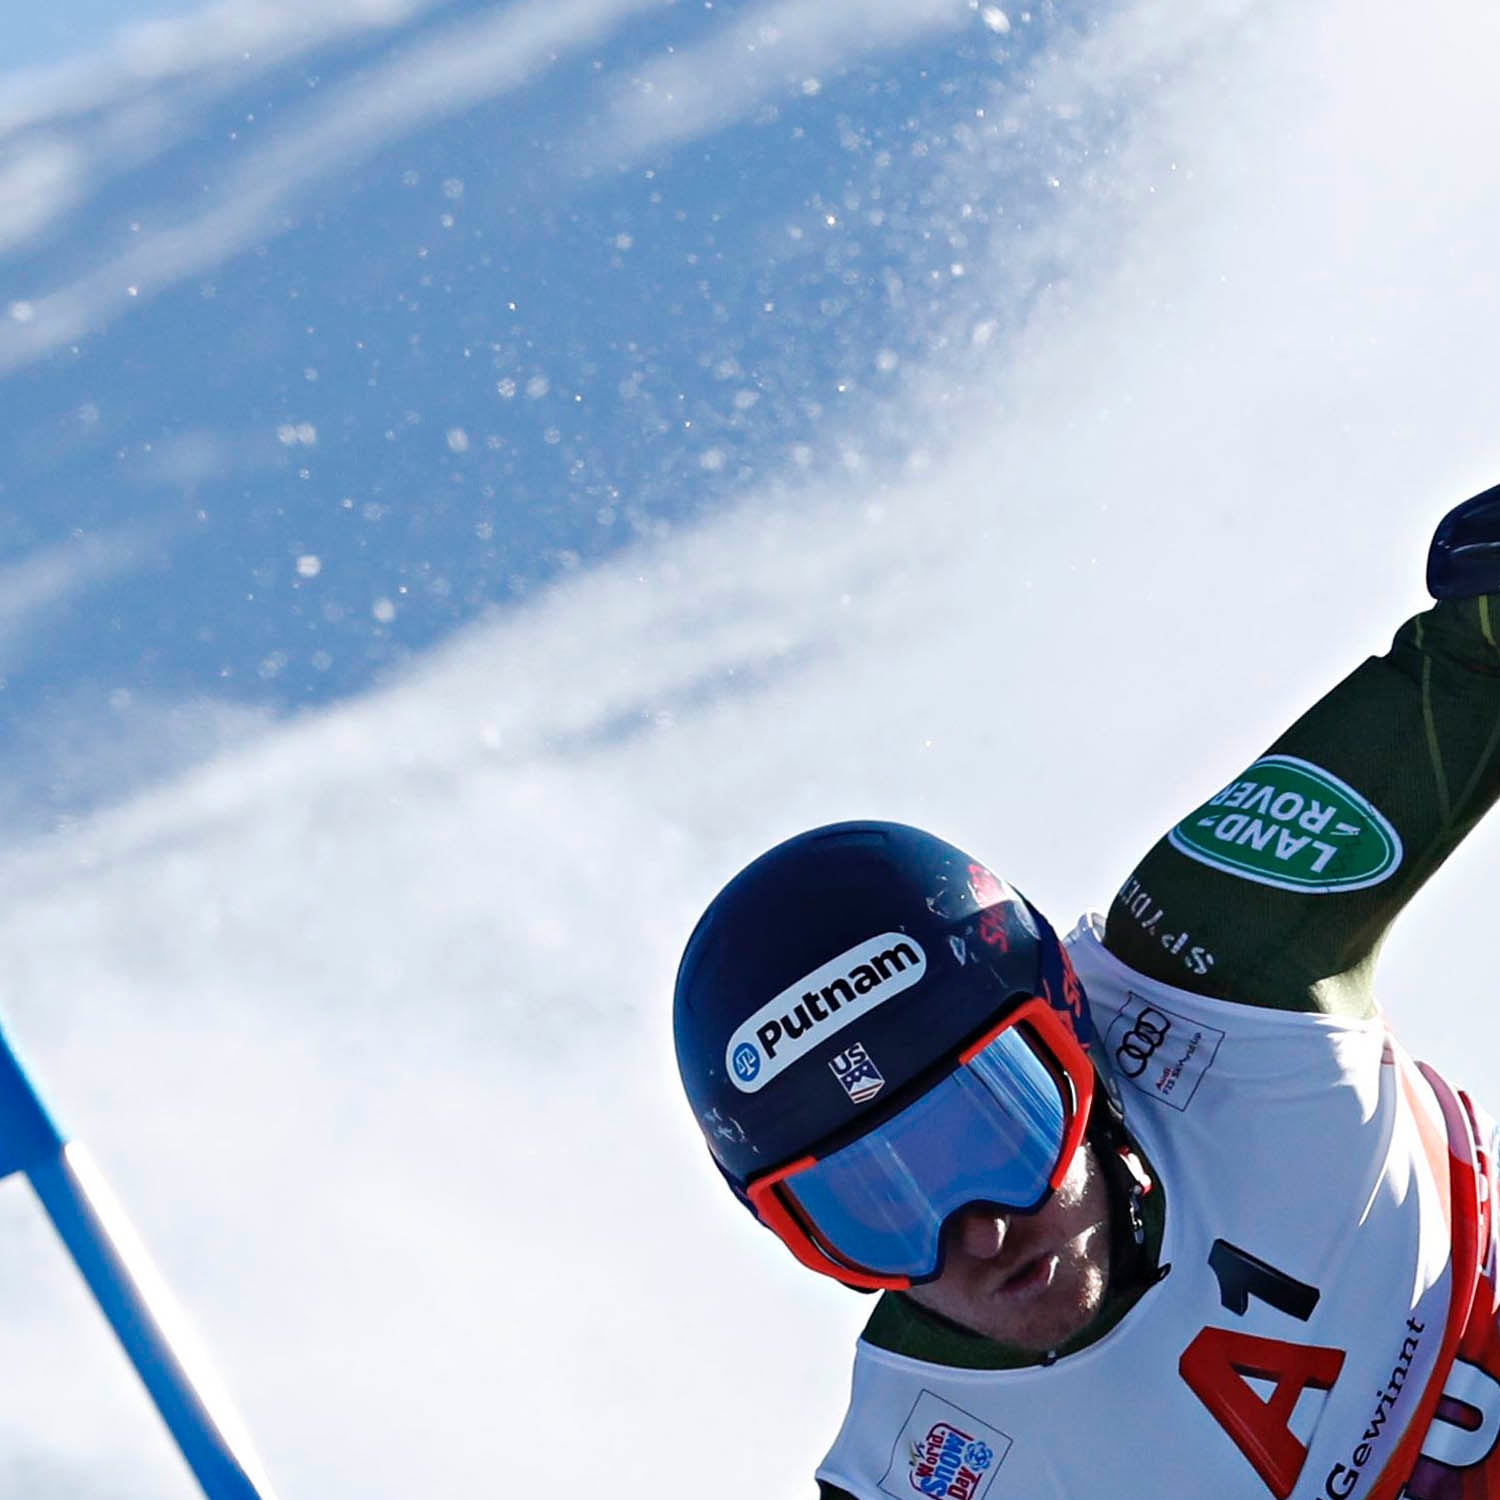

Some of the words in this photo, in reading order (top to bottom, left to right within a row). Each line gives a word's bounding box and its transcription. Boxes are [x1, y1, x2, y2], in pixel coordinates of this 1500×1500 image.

[1209, 782, 1337, 835] ROVER
[1214, 813, 1338, 873] LAND
[756, 942, 921, 1060] Putnam
[829, 1044, 867, 1076] US
[915, 1434, 945, 1478] World
[921, 1432, 966, 1497] Snow
